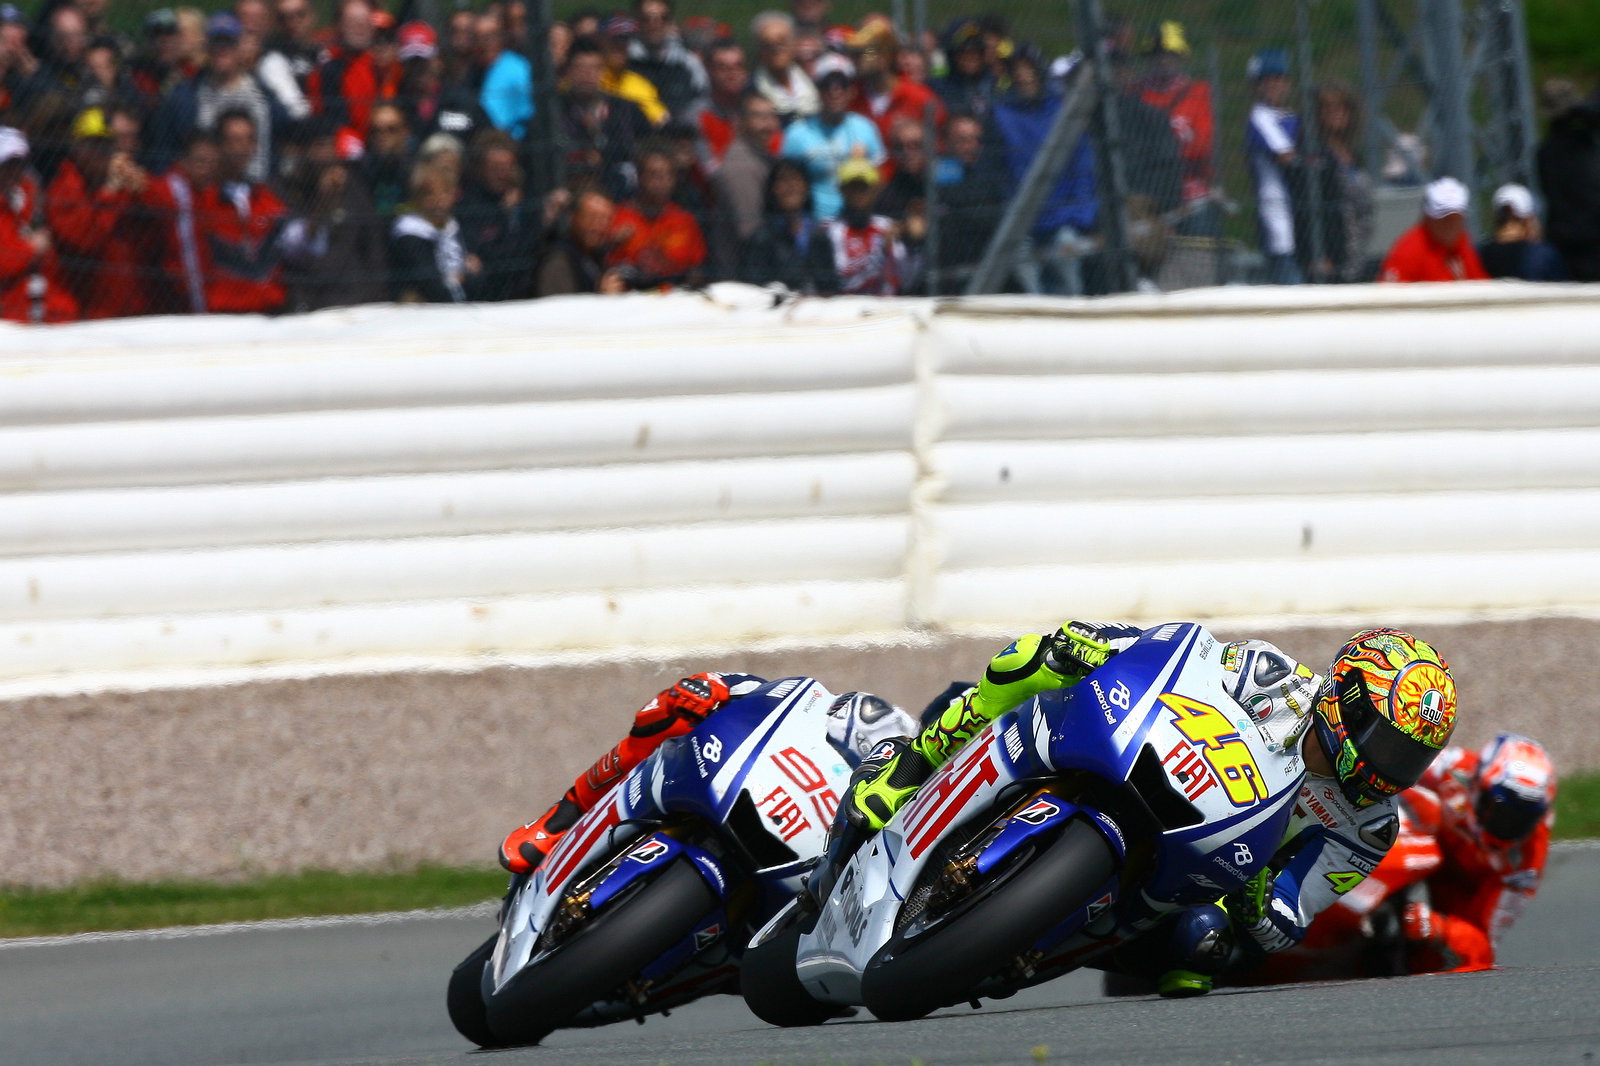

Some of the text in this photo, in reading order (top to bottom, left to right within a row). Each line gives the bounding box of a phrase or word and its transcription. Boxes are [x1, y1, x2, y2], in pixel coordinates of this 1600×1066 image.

[1090, 680, 1110, 711] packard
[1423, 706, 1441, 722] agv
[1003, 722, 1024, 763] YAMAHA
[1157, 692, 1269, 808] 46
[1161, 739, 1218, 802] FIAT
[755, 786, 811, 842] FIAT
[1213, 856, 1240, 877] packard
